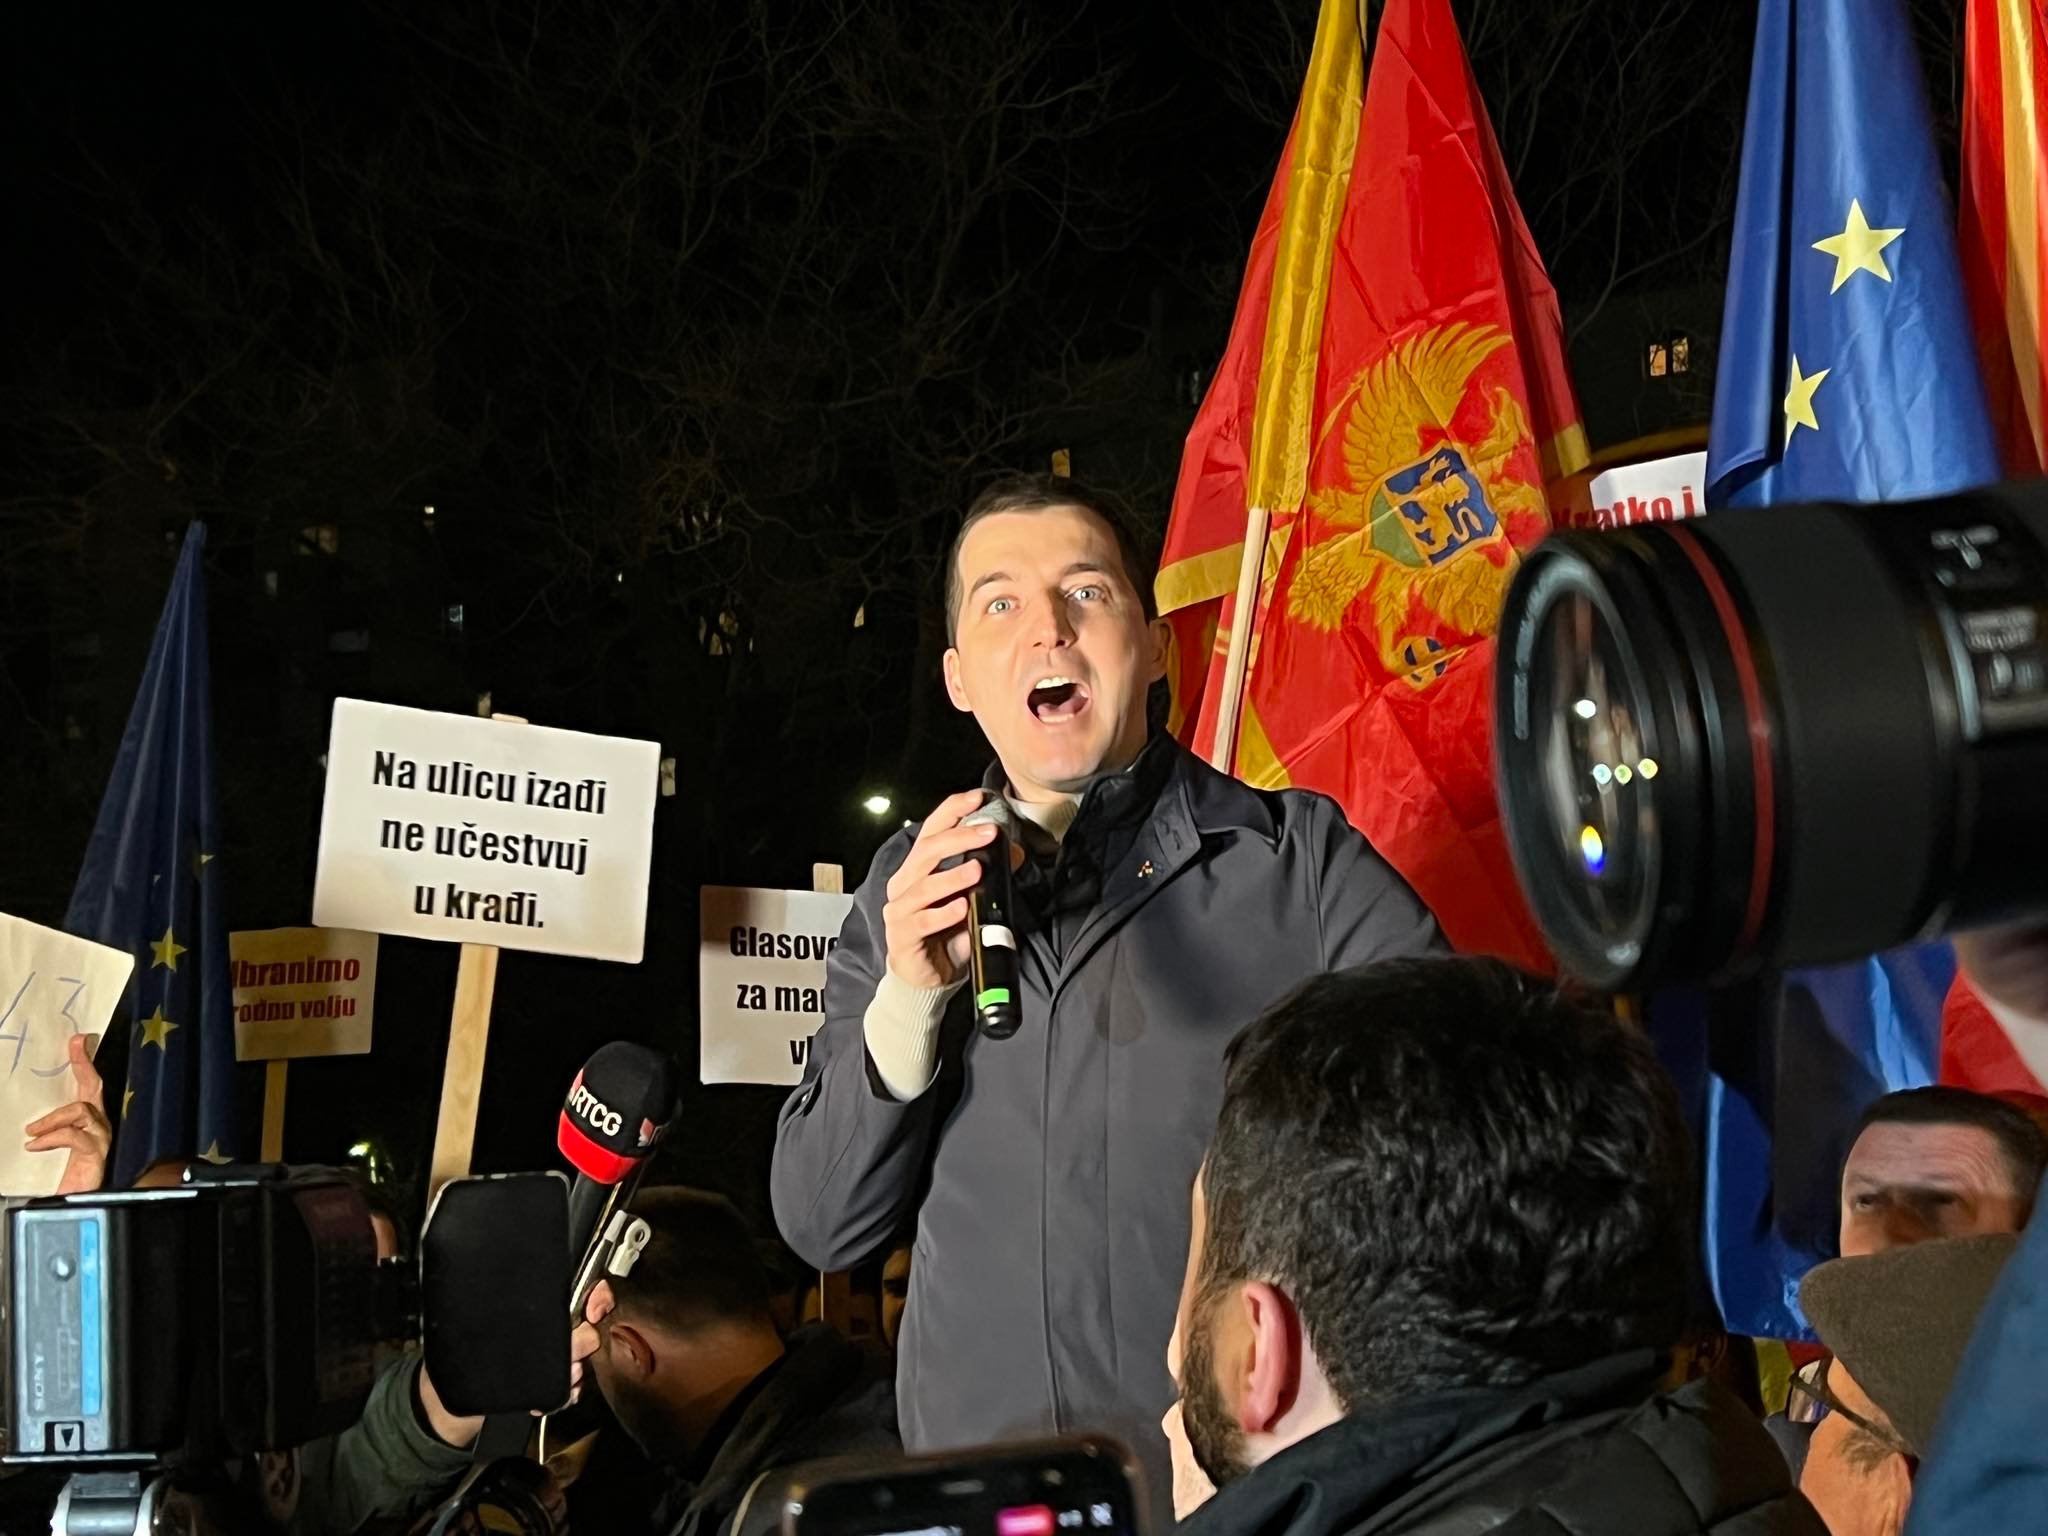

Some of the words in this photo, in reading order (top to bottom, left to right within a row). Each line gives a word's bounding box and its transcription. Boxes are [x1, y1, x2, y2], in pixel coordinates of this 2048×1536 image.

[373, 750, 416, 790] Na
[427, 761, 516, 803] ulicu
[525, 771, 607, 815] izađi
[380, 819, 424, 852] ne
[435, 822, 589, 874] učestvuj
[414, 885, 435, 915] u
[445, 883, 544, 928] krađi.
[301, 995, 356, 1019] volju
[736, 984, 766, 1010] za
[571, 1085, 623, 1137] RTCG
[33, 1352, 45, 1411] SONY
